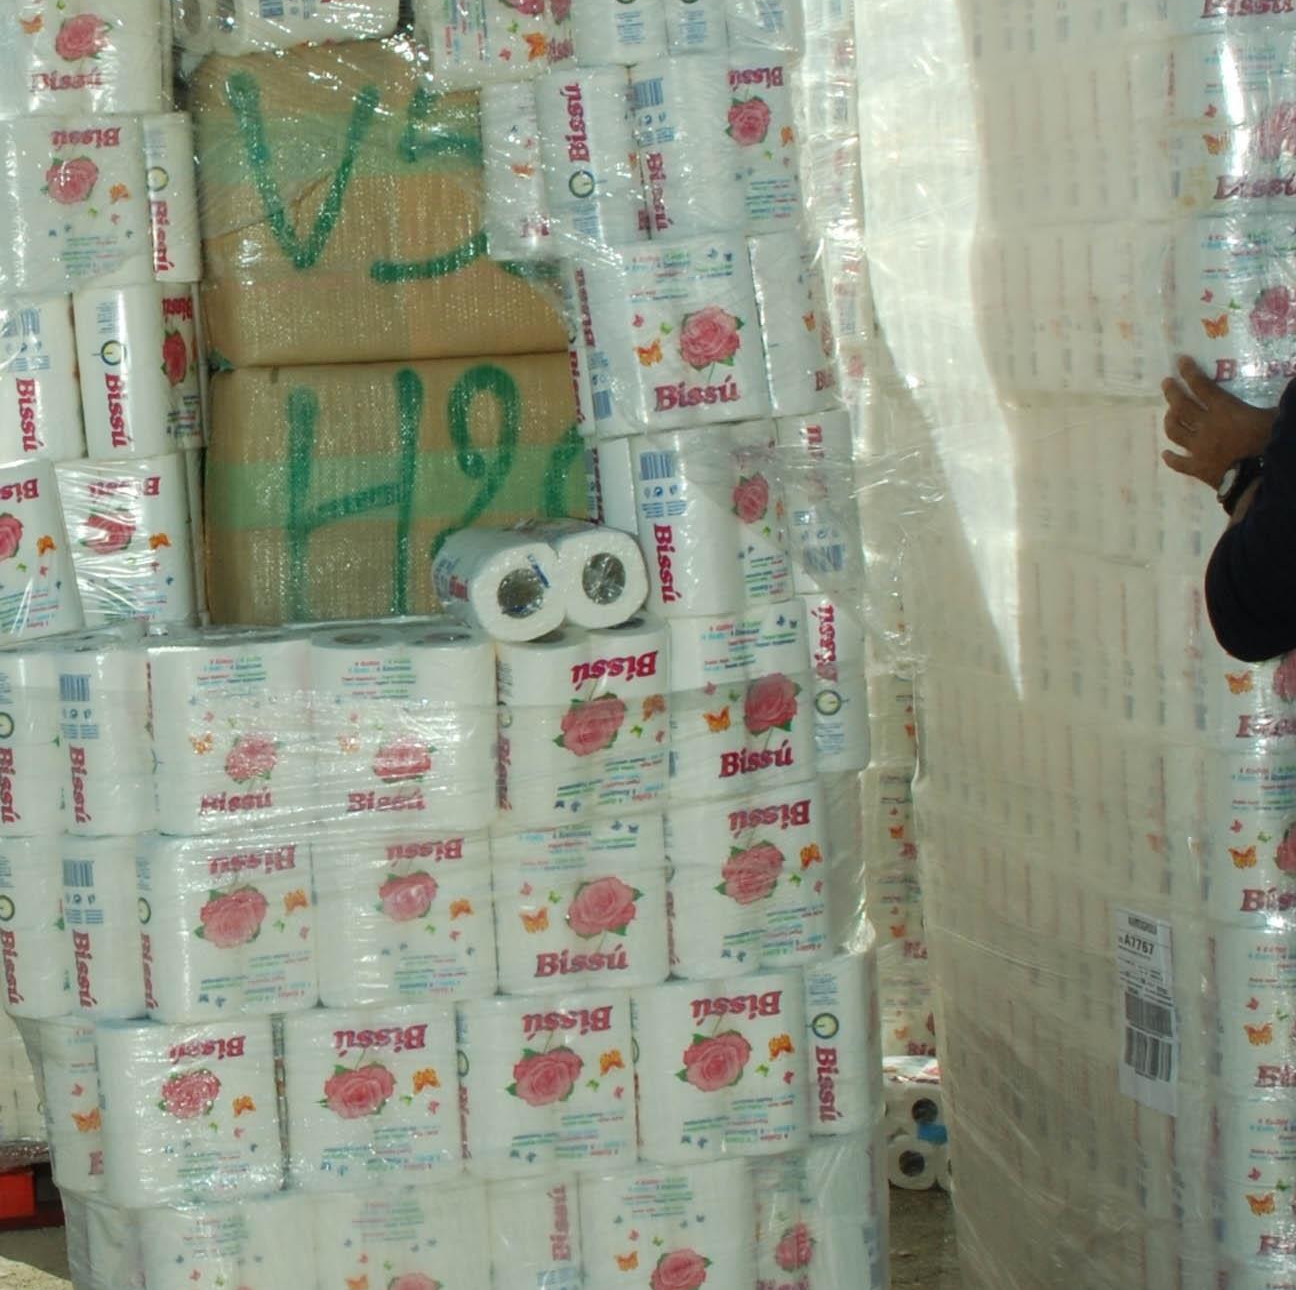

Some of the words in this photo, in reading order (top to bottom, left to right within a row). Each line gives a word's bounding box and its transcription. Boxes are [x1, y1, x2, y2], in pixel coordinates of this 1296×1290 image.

[105, 373, 137, 447] Bissú
[656, 378, 739, 410] Bissú
[16, 379, 43, 451] Bissú
[654, 524, 680, 602] Bissú
[571, 652, 656, 688] Bissú
[720, 739, 793, 777] Bissú
[537, 945, 628, 976] Bissú
[691, 991, 780, 1023] Bissú
[334, 1025, 426, 1052] Bissú
